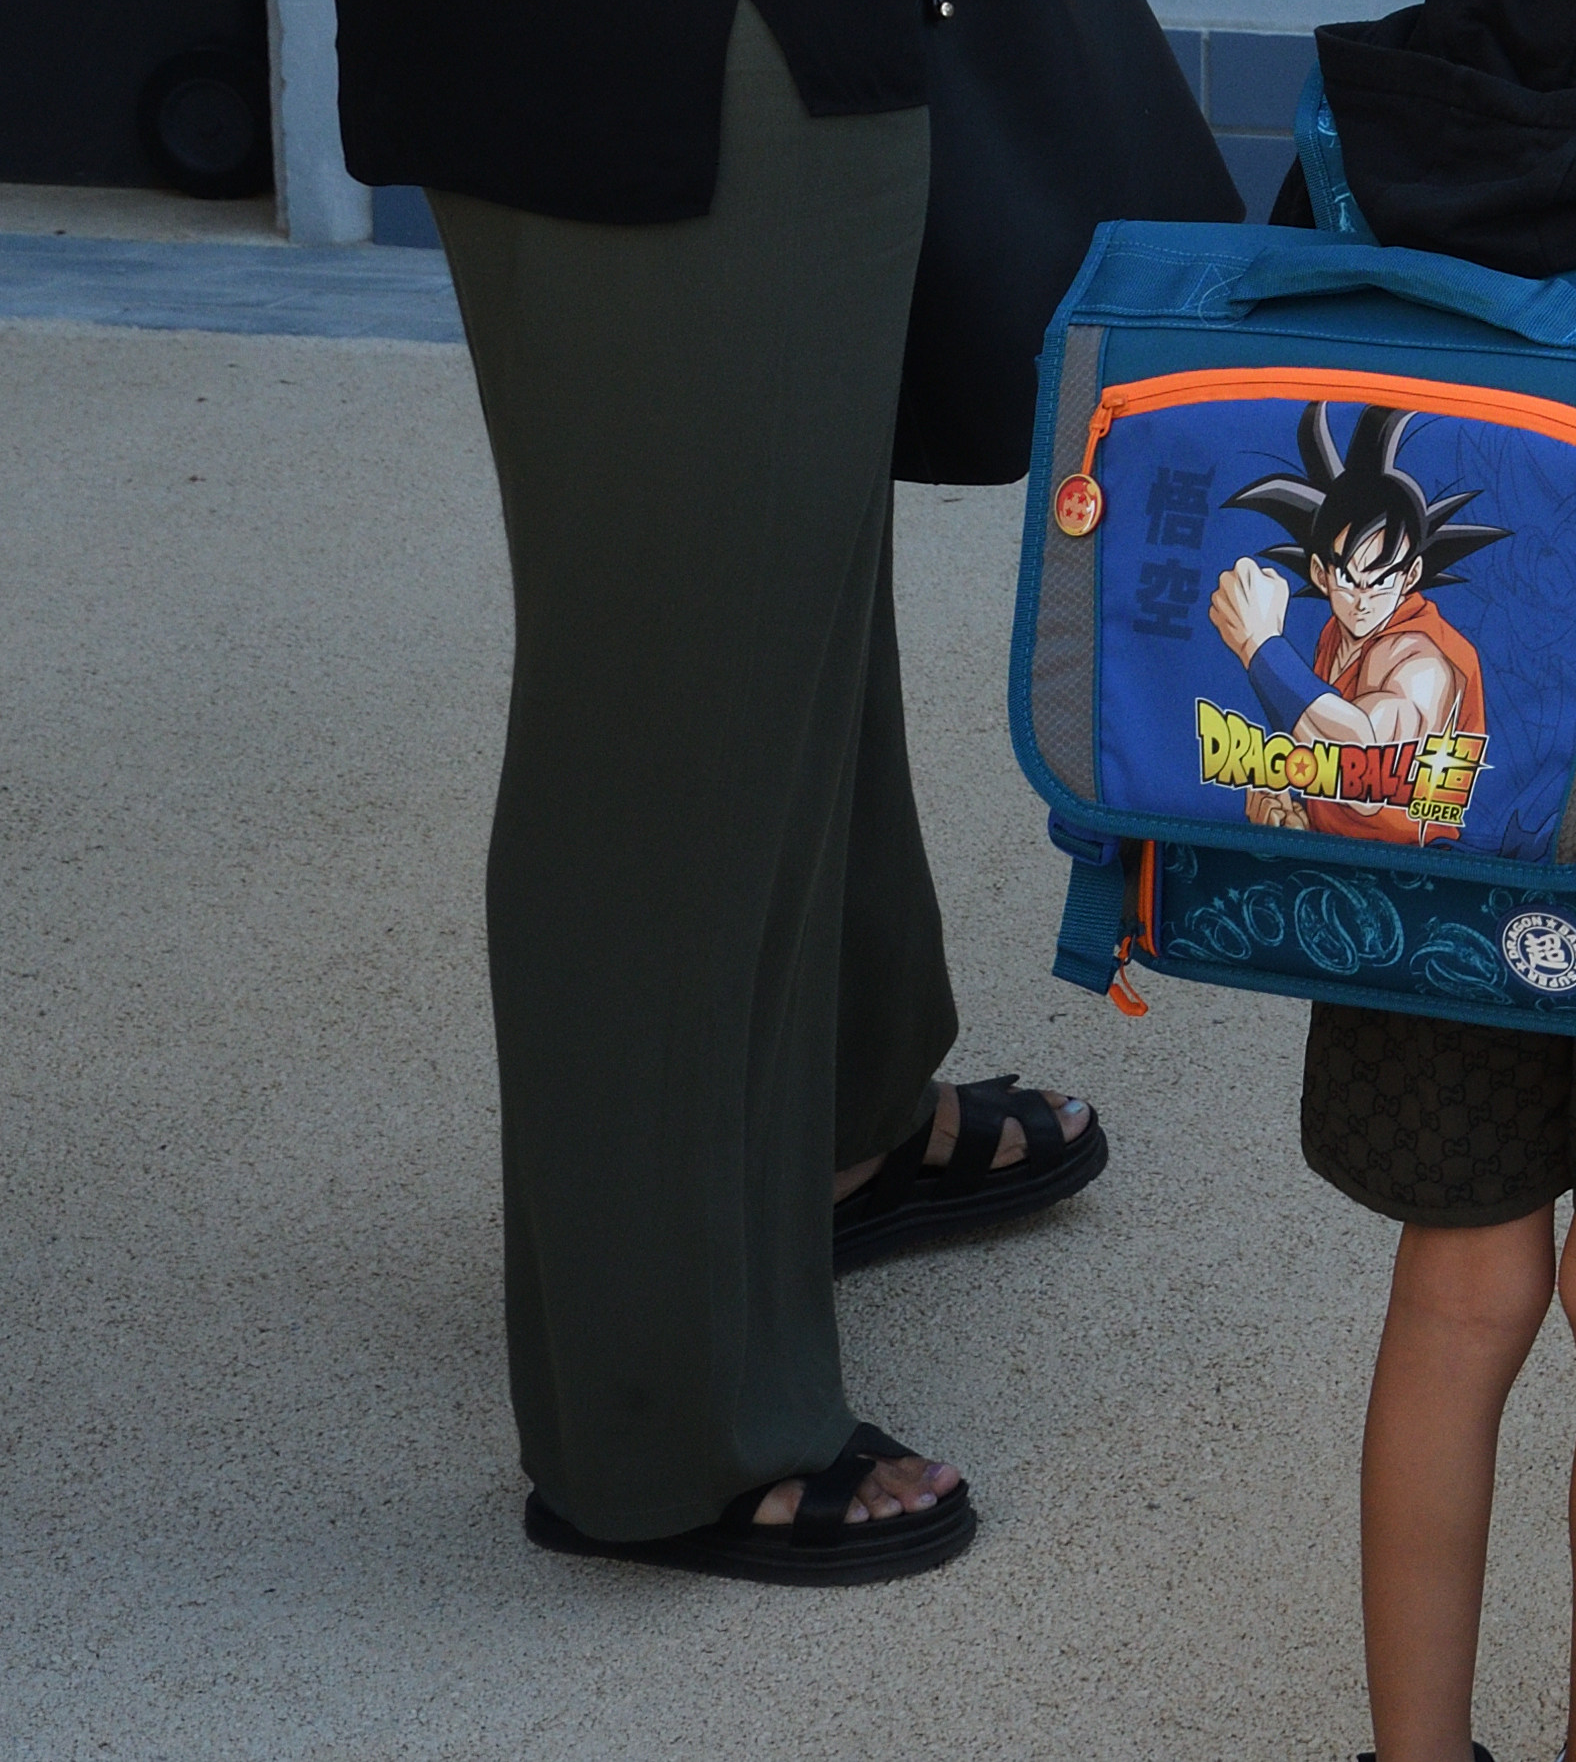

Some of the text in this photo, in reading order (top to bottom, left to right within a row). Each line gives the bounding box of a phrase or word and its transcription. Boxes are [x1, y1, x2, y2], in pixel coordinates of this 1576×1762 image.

[1133, 465, 1216, 640] 悟空
[1197, 698, 1340, 799] DRAGON
[1340, 740, 1420, 804] BALL
[1409, 801, 1461, 823] SUPER
[1506, 916, 1543, 959] DRAGON
